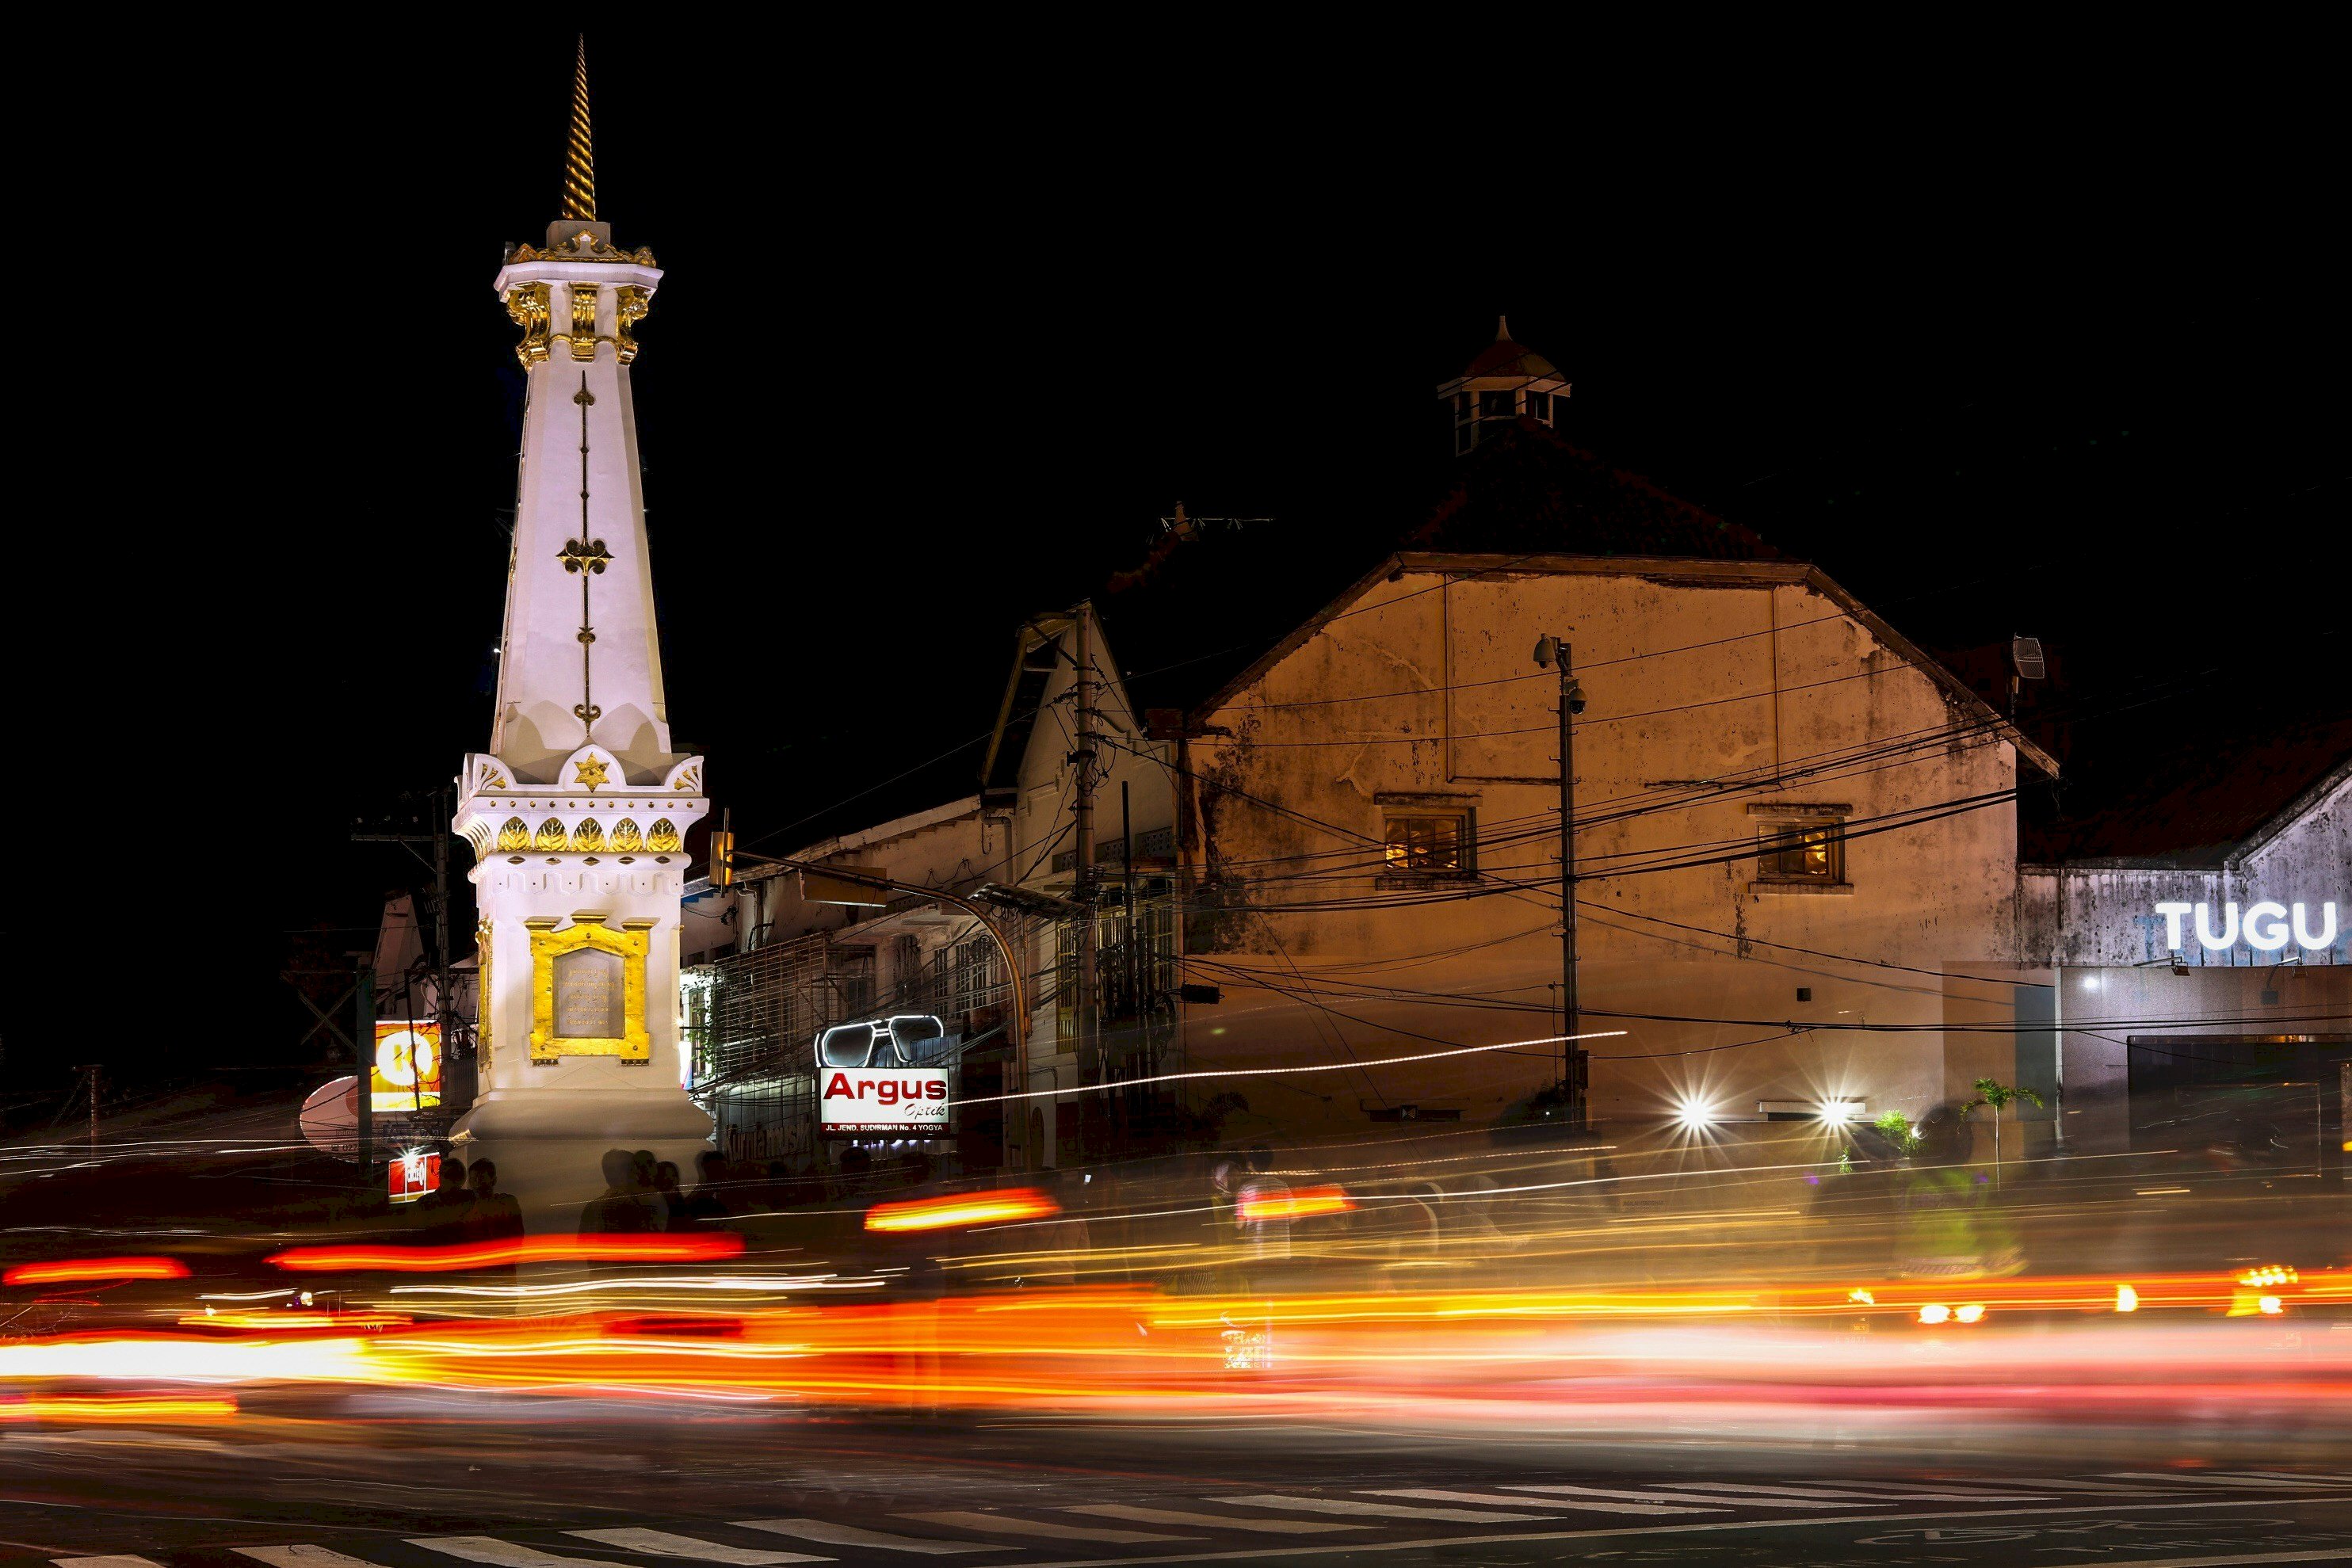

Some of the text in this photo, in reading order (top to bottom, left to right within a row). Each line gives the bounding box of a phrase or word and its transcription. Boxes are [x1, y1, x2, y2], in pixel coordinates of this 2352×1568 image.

[2155, 902, 2337, 950] TUGU
[823, 1073, 947, 1105] Argus
[904, 1102, 946, 1120] Optik
